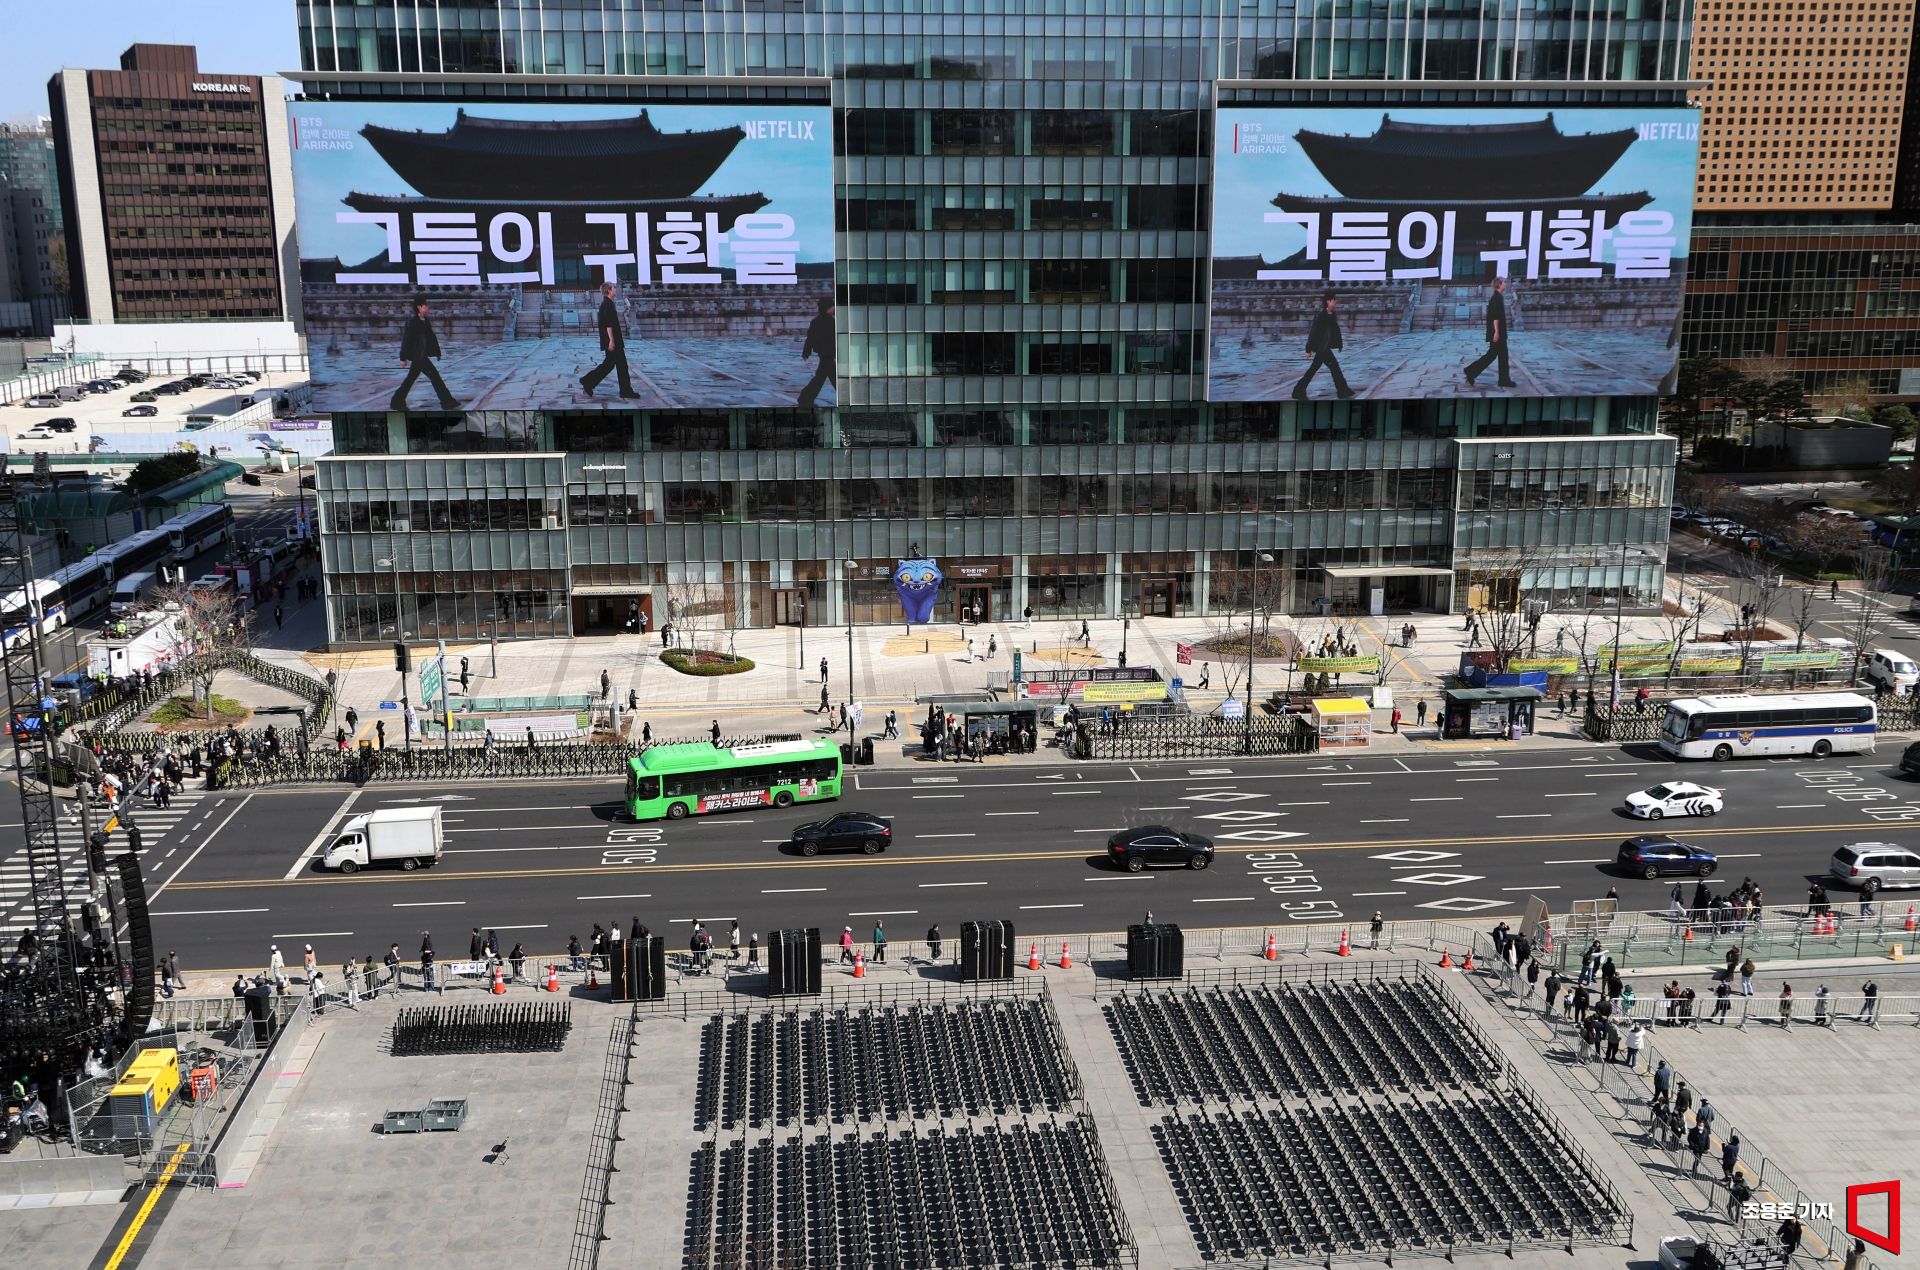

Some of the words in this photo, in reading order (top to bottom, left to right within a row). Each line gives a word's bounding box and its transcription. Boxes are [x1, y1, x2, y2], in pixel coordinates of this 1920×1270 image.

[192, 83, 237, 92] KOREAN
[239, 84, 251, 93] Re
[301, 117, 323, 127] BTS
[1242, 123, 1262, 132] BTS
[322, 129, 352, 139] 라이브
[745, 120, 814, 140] NETFLIX
[1639, 122, 1699, 141] NETFLIX
[303, 140, 353, 150] ARIRANG
[1260, 134, 1285, 144] 라이브
[1241, 145, 1287, 154] ARIRANG
[335, 212, 555, 285] 그들의
[583, 212, 800, 285] 귀환을
[1256, 211, 1457, 280] 그들의
[1480, 210, 1677, 280] 귀환을
[777, 778, 791, 786] 7212
[705, 798, 732, 810] 해커스
[733, 795, 760, 808] 라이브
[1246, 853, 1304, 869] 50
[1263, 876, 1323, 893] 50
[1281, 901, 1344, 919] 50
